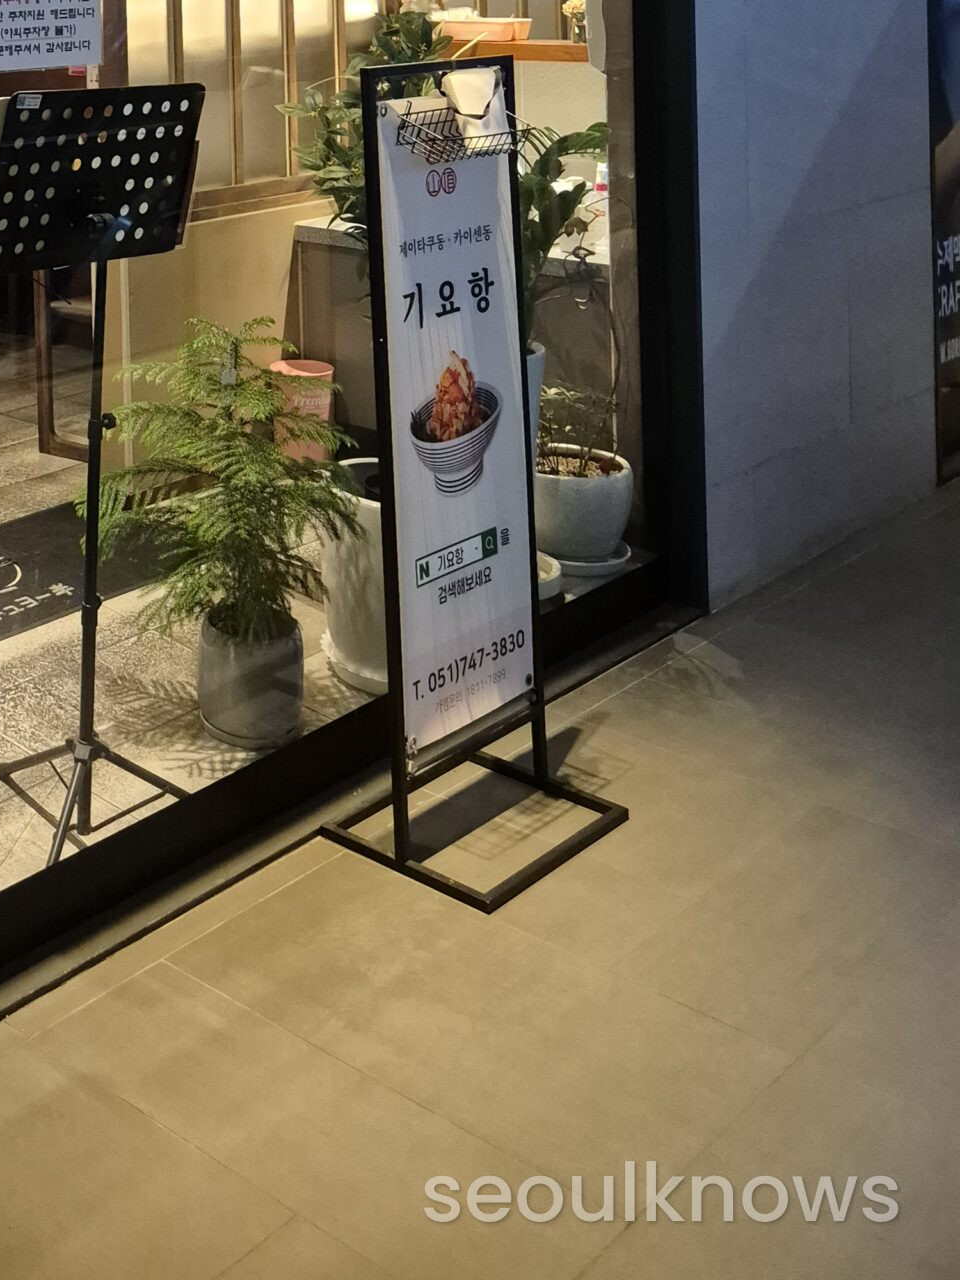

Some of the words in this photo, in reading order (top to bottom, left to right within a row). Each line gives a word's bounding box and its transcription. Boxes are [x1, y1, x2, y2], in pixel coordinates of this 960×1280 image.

[0, 25, 50, 40] (야외주차장
[54, 23, 77, 36] 불가)
[8, 9, 45, 22] 주차지원
[50, 7, 95, 20] 해드립니다
[45, 39, 91, 54] 감사합니다
[399, 233, 446, 258] 제이타쿠동
[453, 224, 493, 246] 카이센동
[401, 266, 495, 329] 기요항
[418, 560, 431, 581] N
[437, 546, 464, 572] 기요항
[500, 527, 510, 546] 을
[437, 566, 493, 605] 검색해보세요
[412, 680, 425, 702] T.
[427, 629, 526, 693] 051)747-3830
